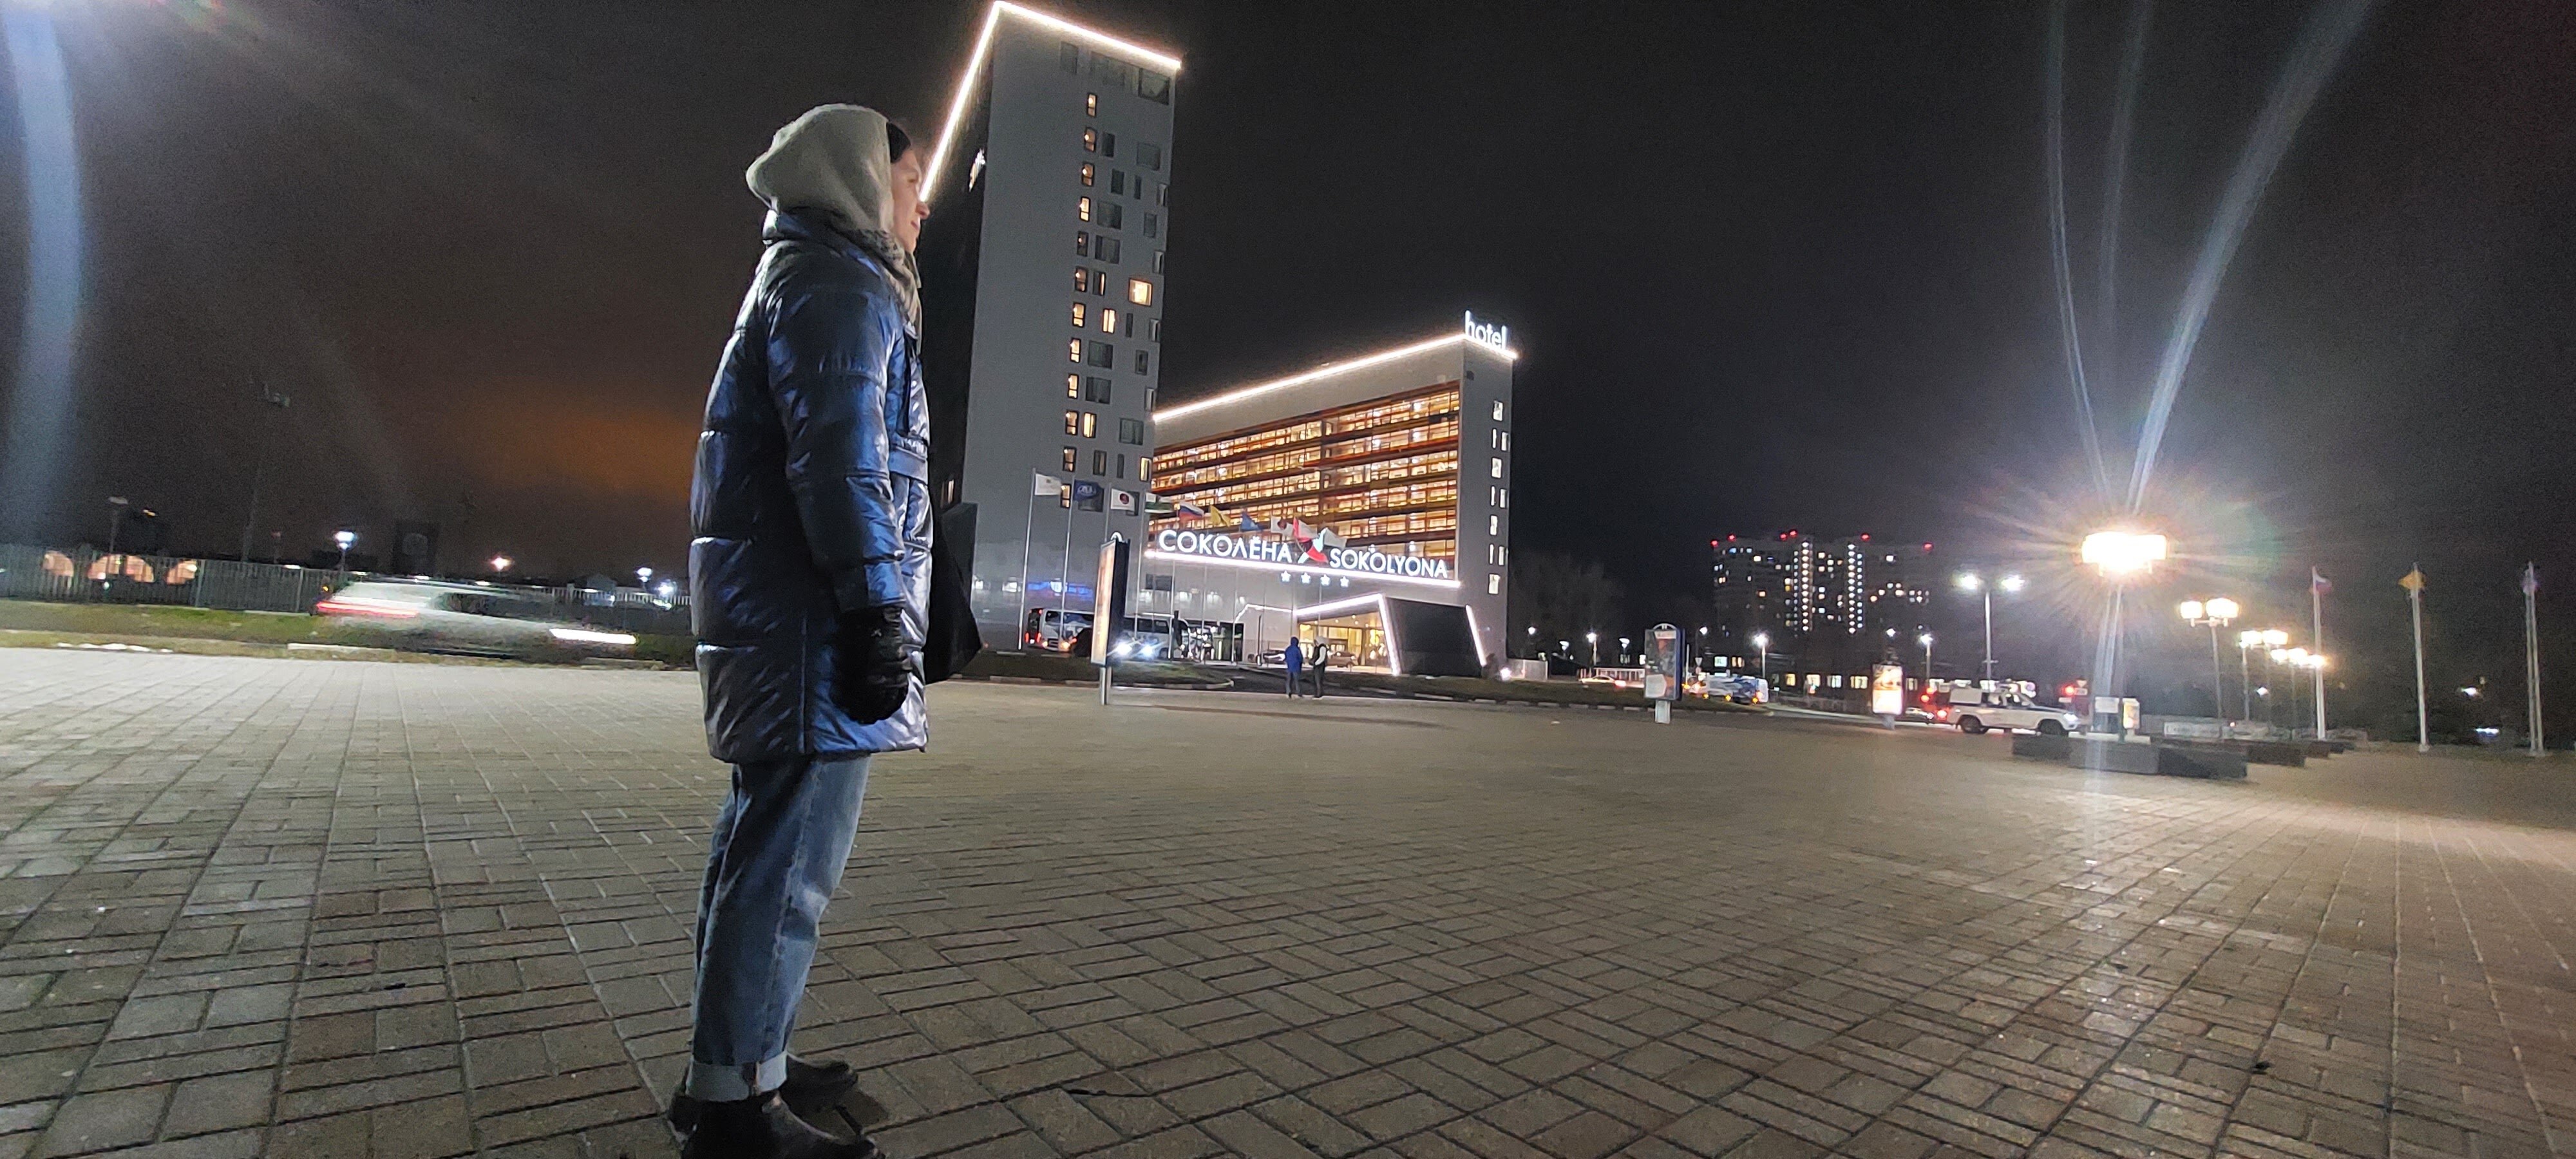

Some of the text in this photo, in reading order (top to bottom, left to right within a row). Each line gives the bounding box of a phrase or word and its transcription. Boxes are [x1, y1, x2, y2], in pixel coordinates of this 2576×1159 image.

[1464, 310, 1507, 350] hotel
[1159, 529, 1293, 563] СОКОЛЁНА
[1329, 548, 1448, 578] SOKOLYONA
